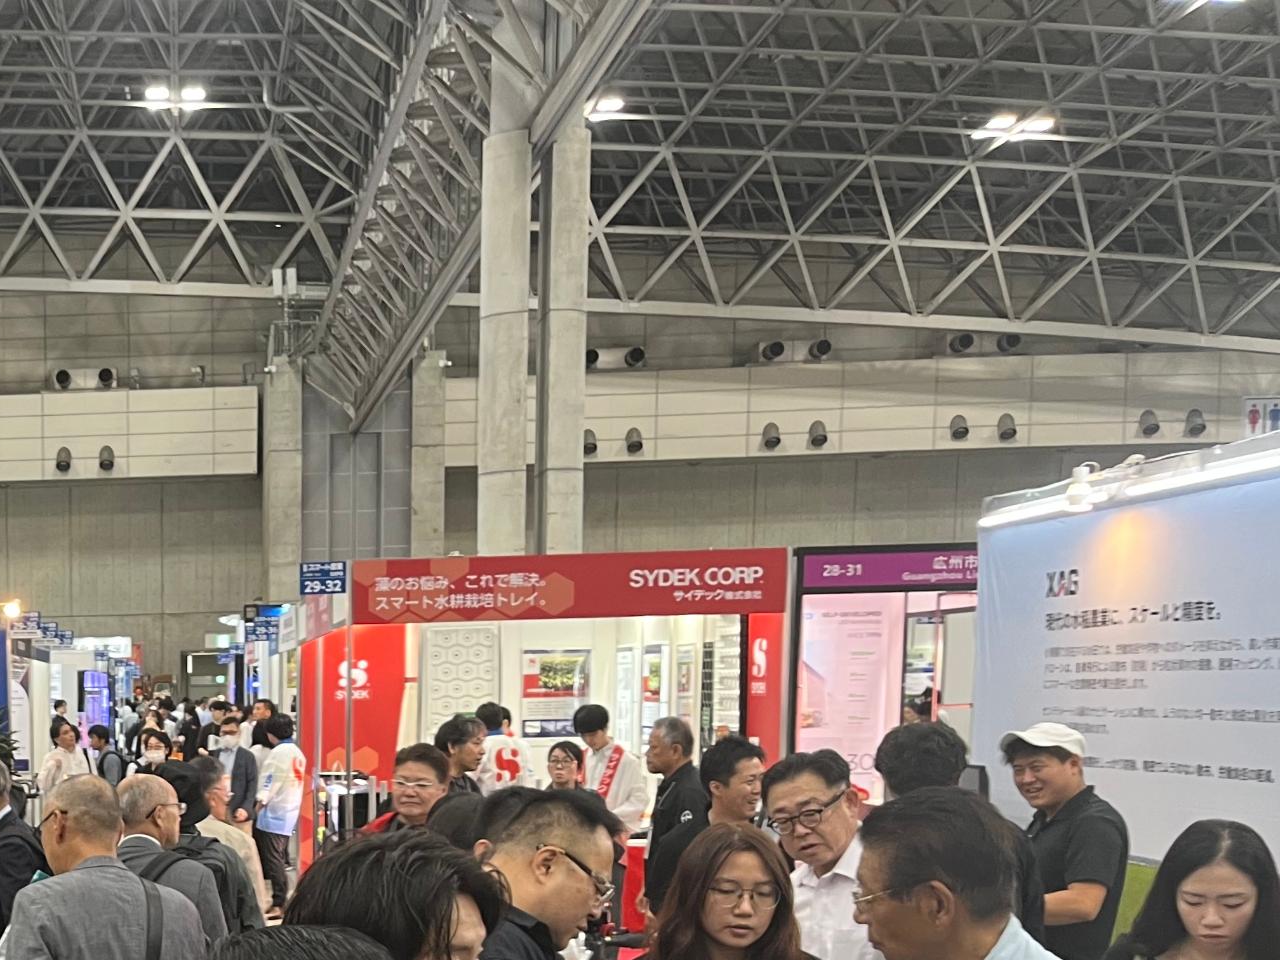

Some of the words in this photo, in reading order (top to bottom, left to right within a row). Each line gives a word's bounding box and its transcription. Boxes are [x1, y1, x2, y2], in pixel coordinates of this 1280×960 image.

[304, 579, 342, 593] 29-32
[629, 568, 701, 588] SYDEK
[704, 566, 765, 586] CORP.
[1045, 569, 1080, 598] XAG
